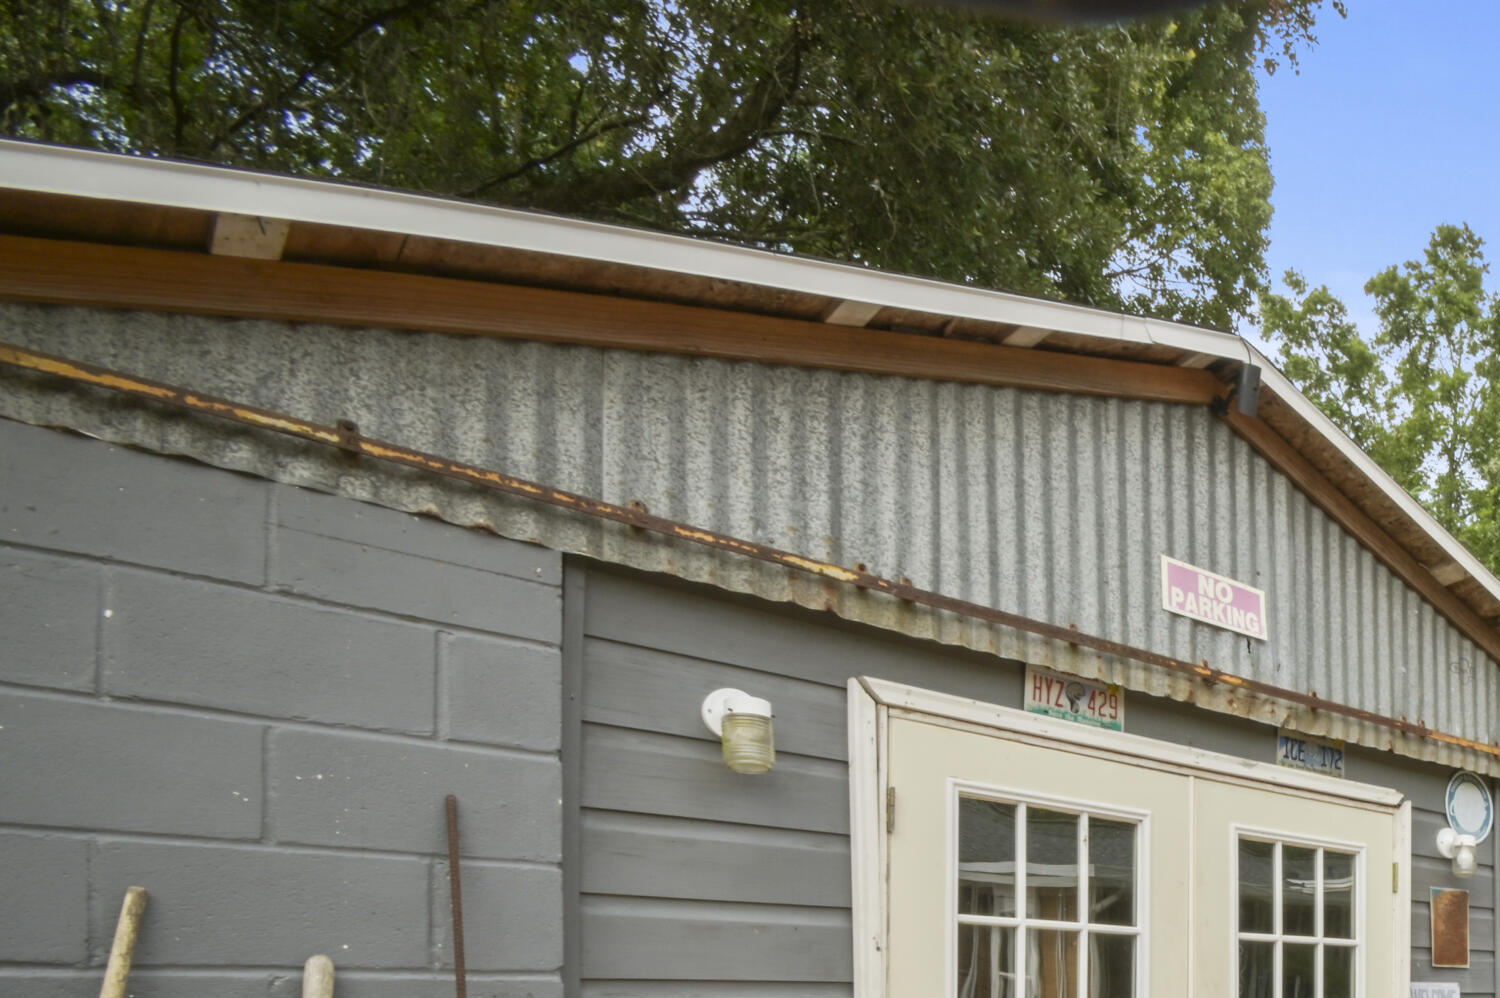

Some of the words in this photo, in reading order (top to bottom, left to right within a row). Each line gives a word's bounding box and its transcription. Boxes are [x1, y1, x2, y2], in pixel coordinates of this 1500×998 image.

[1170, 586, 1261, 633] PARKING
[1197, 574, 1234, 604] NO
[1032, 673, 1065, 709] HYZ
[1087, 689, 1118, 721] 429
